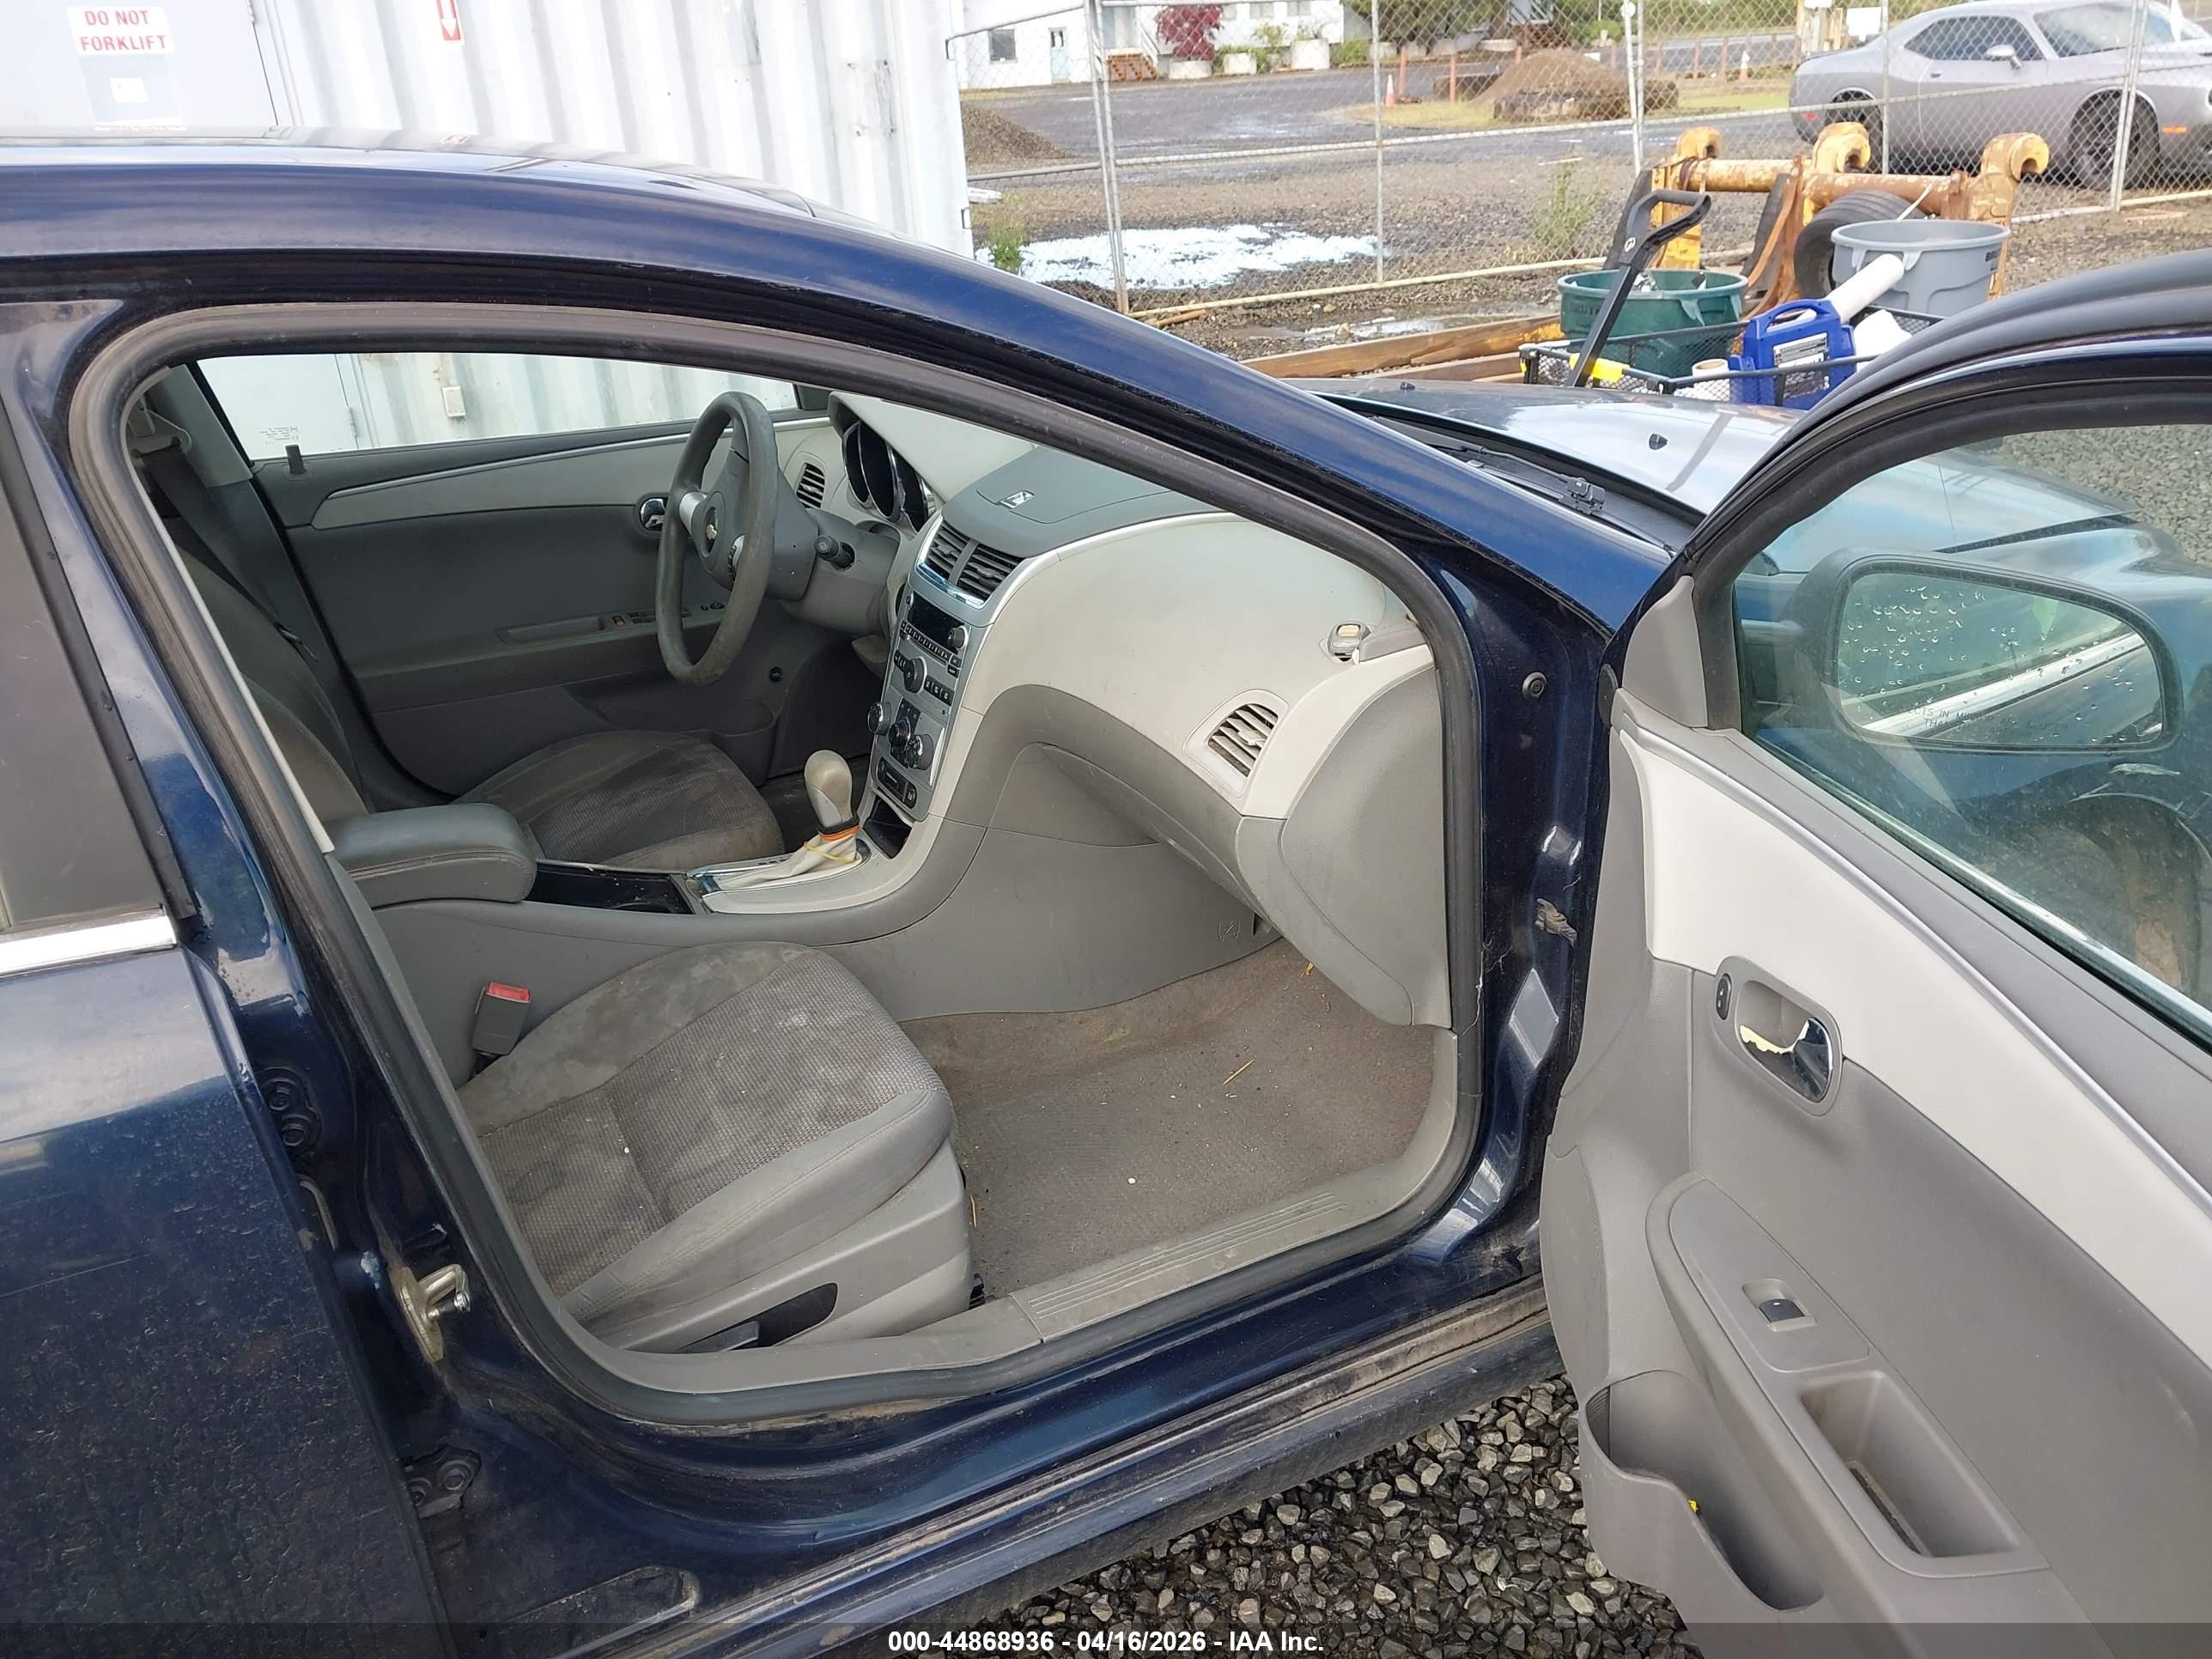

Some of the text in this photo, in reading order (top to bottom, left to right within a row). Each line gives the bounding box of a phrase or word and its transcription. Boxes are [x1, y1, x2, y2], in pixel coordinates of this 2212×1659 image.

[84, 10, 149, 26] DO NOT
[80, 35, 166, 51] FORKLIFT
[1940, 709, 1950, 719] IN
